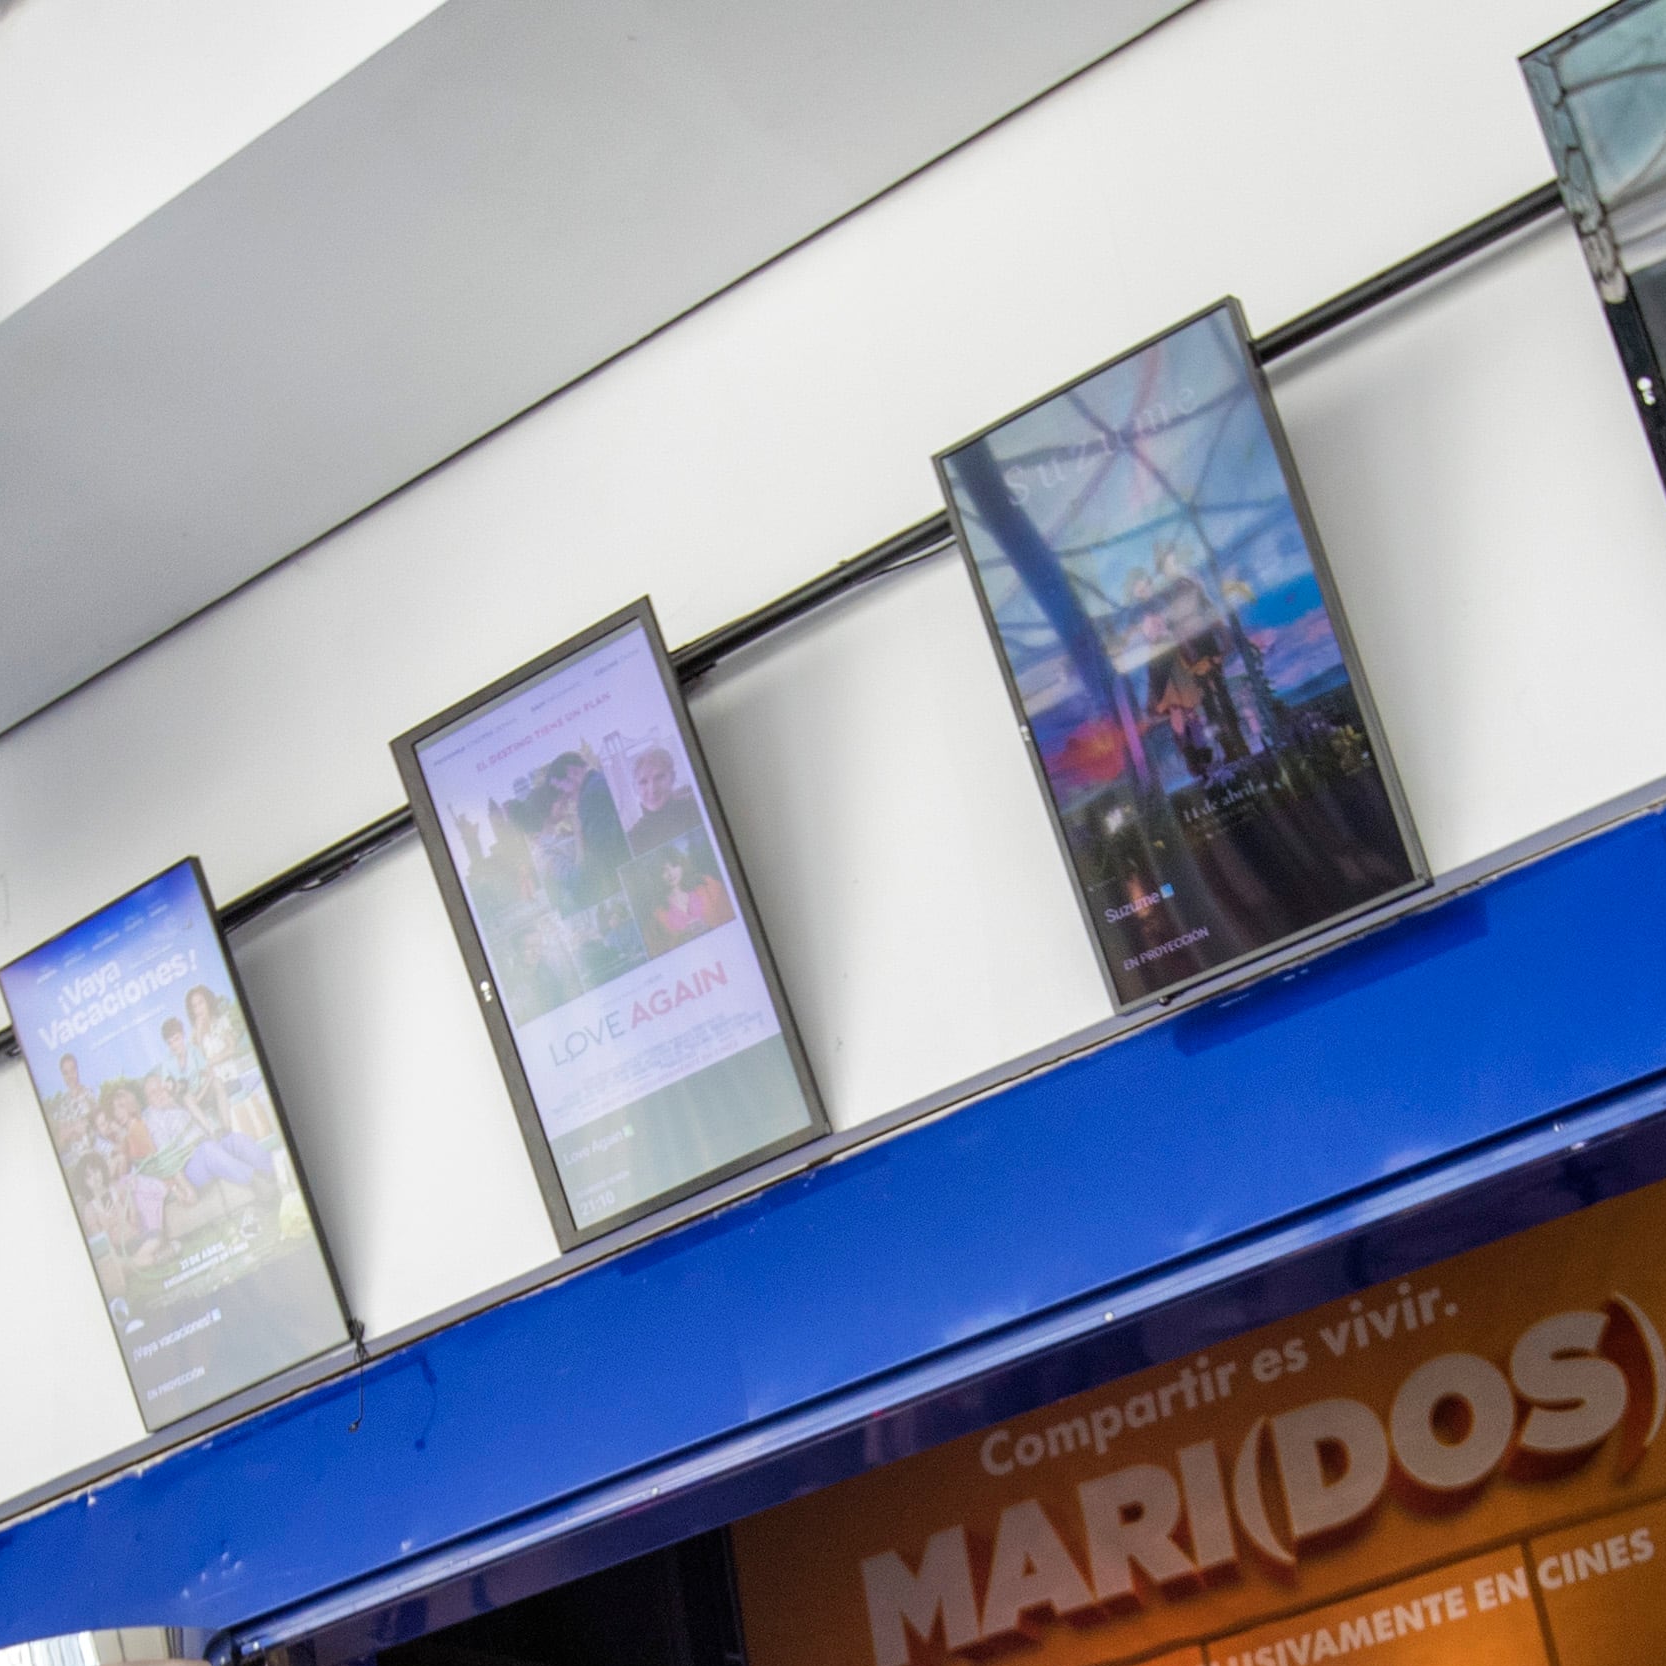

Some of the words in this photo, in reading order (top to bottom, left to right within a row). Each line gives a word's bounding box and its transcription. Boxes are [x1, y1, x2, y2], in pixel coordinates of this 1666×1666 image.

[1104, 891, 1161, 924] Suzume
[37, 949, 199, 1051] Vacaciones!
[1123, 956, 1141, 971] EN
[548, 1010, 627, 1068] LOVE
[629, 960, 729, 1031] AGAIN
[979, 1357, 1244, 1479] Compartir
[1251, 1336, 1310, 1386] es
[1319, 1283, 1461, 1361] vivir.
[1474, 1563, 1533, 1615] EN
[1536, 1526, 1658, 1593] CINES
